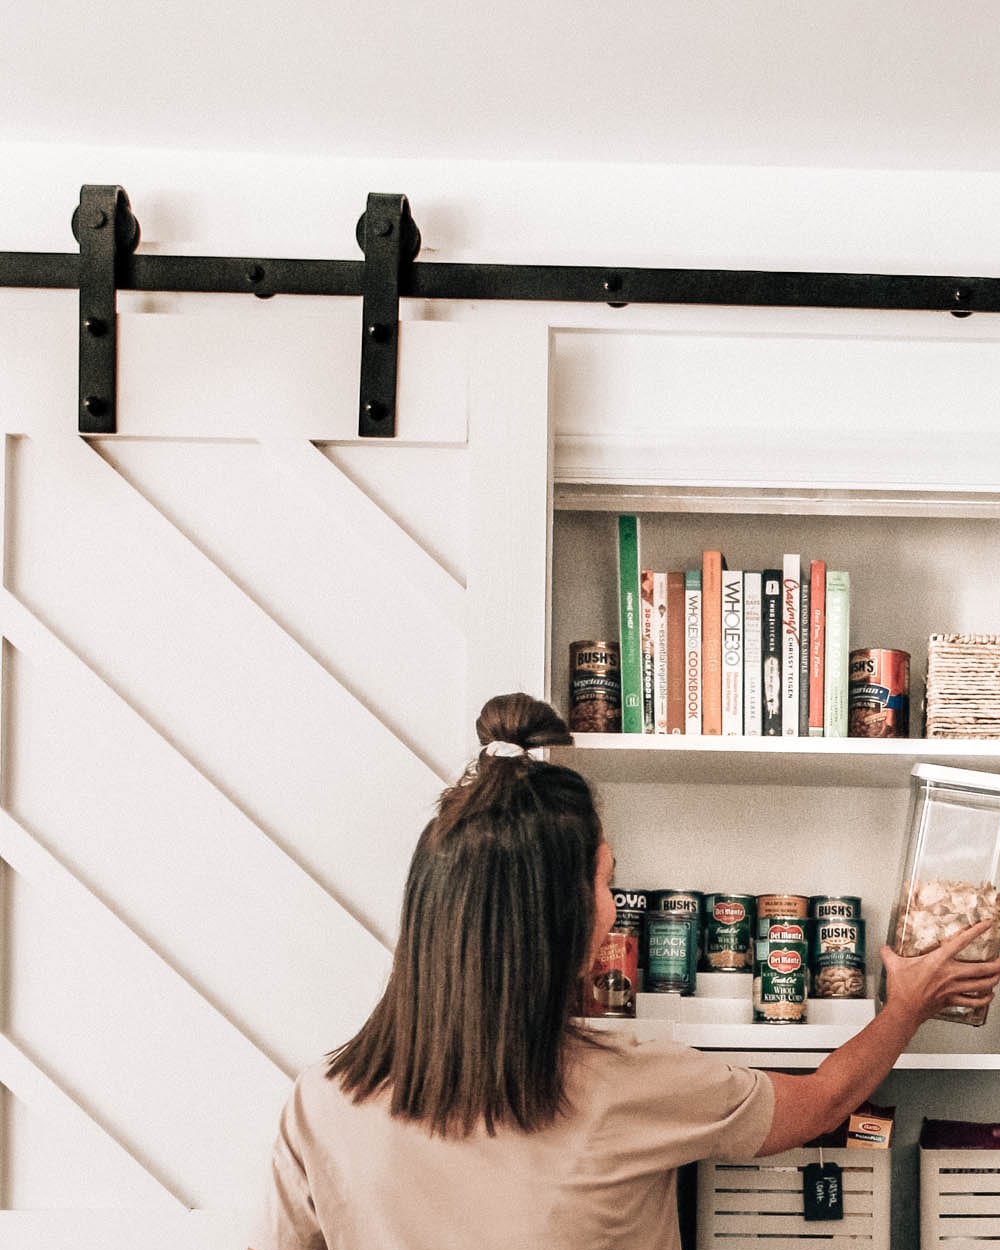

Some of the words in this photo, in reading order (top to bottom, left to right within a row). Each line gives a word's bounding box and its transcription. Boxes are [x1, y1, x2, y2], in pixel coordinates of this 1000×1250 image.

[783, 579, 799, 645] Cravings
[724, 581, 740, 666] WHOLE30
[578, 652, 617, 665] BUSH'S
[658, 664, 666, 700] vegetable
[688, 651, 698, 719] COOKBOOK
[614, 894, 647, 908] OYA
[663, 899, 698, 912] BUSH'S
[819, 905, 852, 917] BUSH'S
[770, 931, 780, 940] Del
[781, 931, 802, 940] Monte
[821, 927, 856, 940] BUSH'S
[649, 936, 687, 947] BLACK
[649, 948, 686, 957] BEANS
[773, 986, 796, 994] WHOLE
[764, 993, 787, 1001] KERNEL
[824, 1176, 837, 1207] pasta
